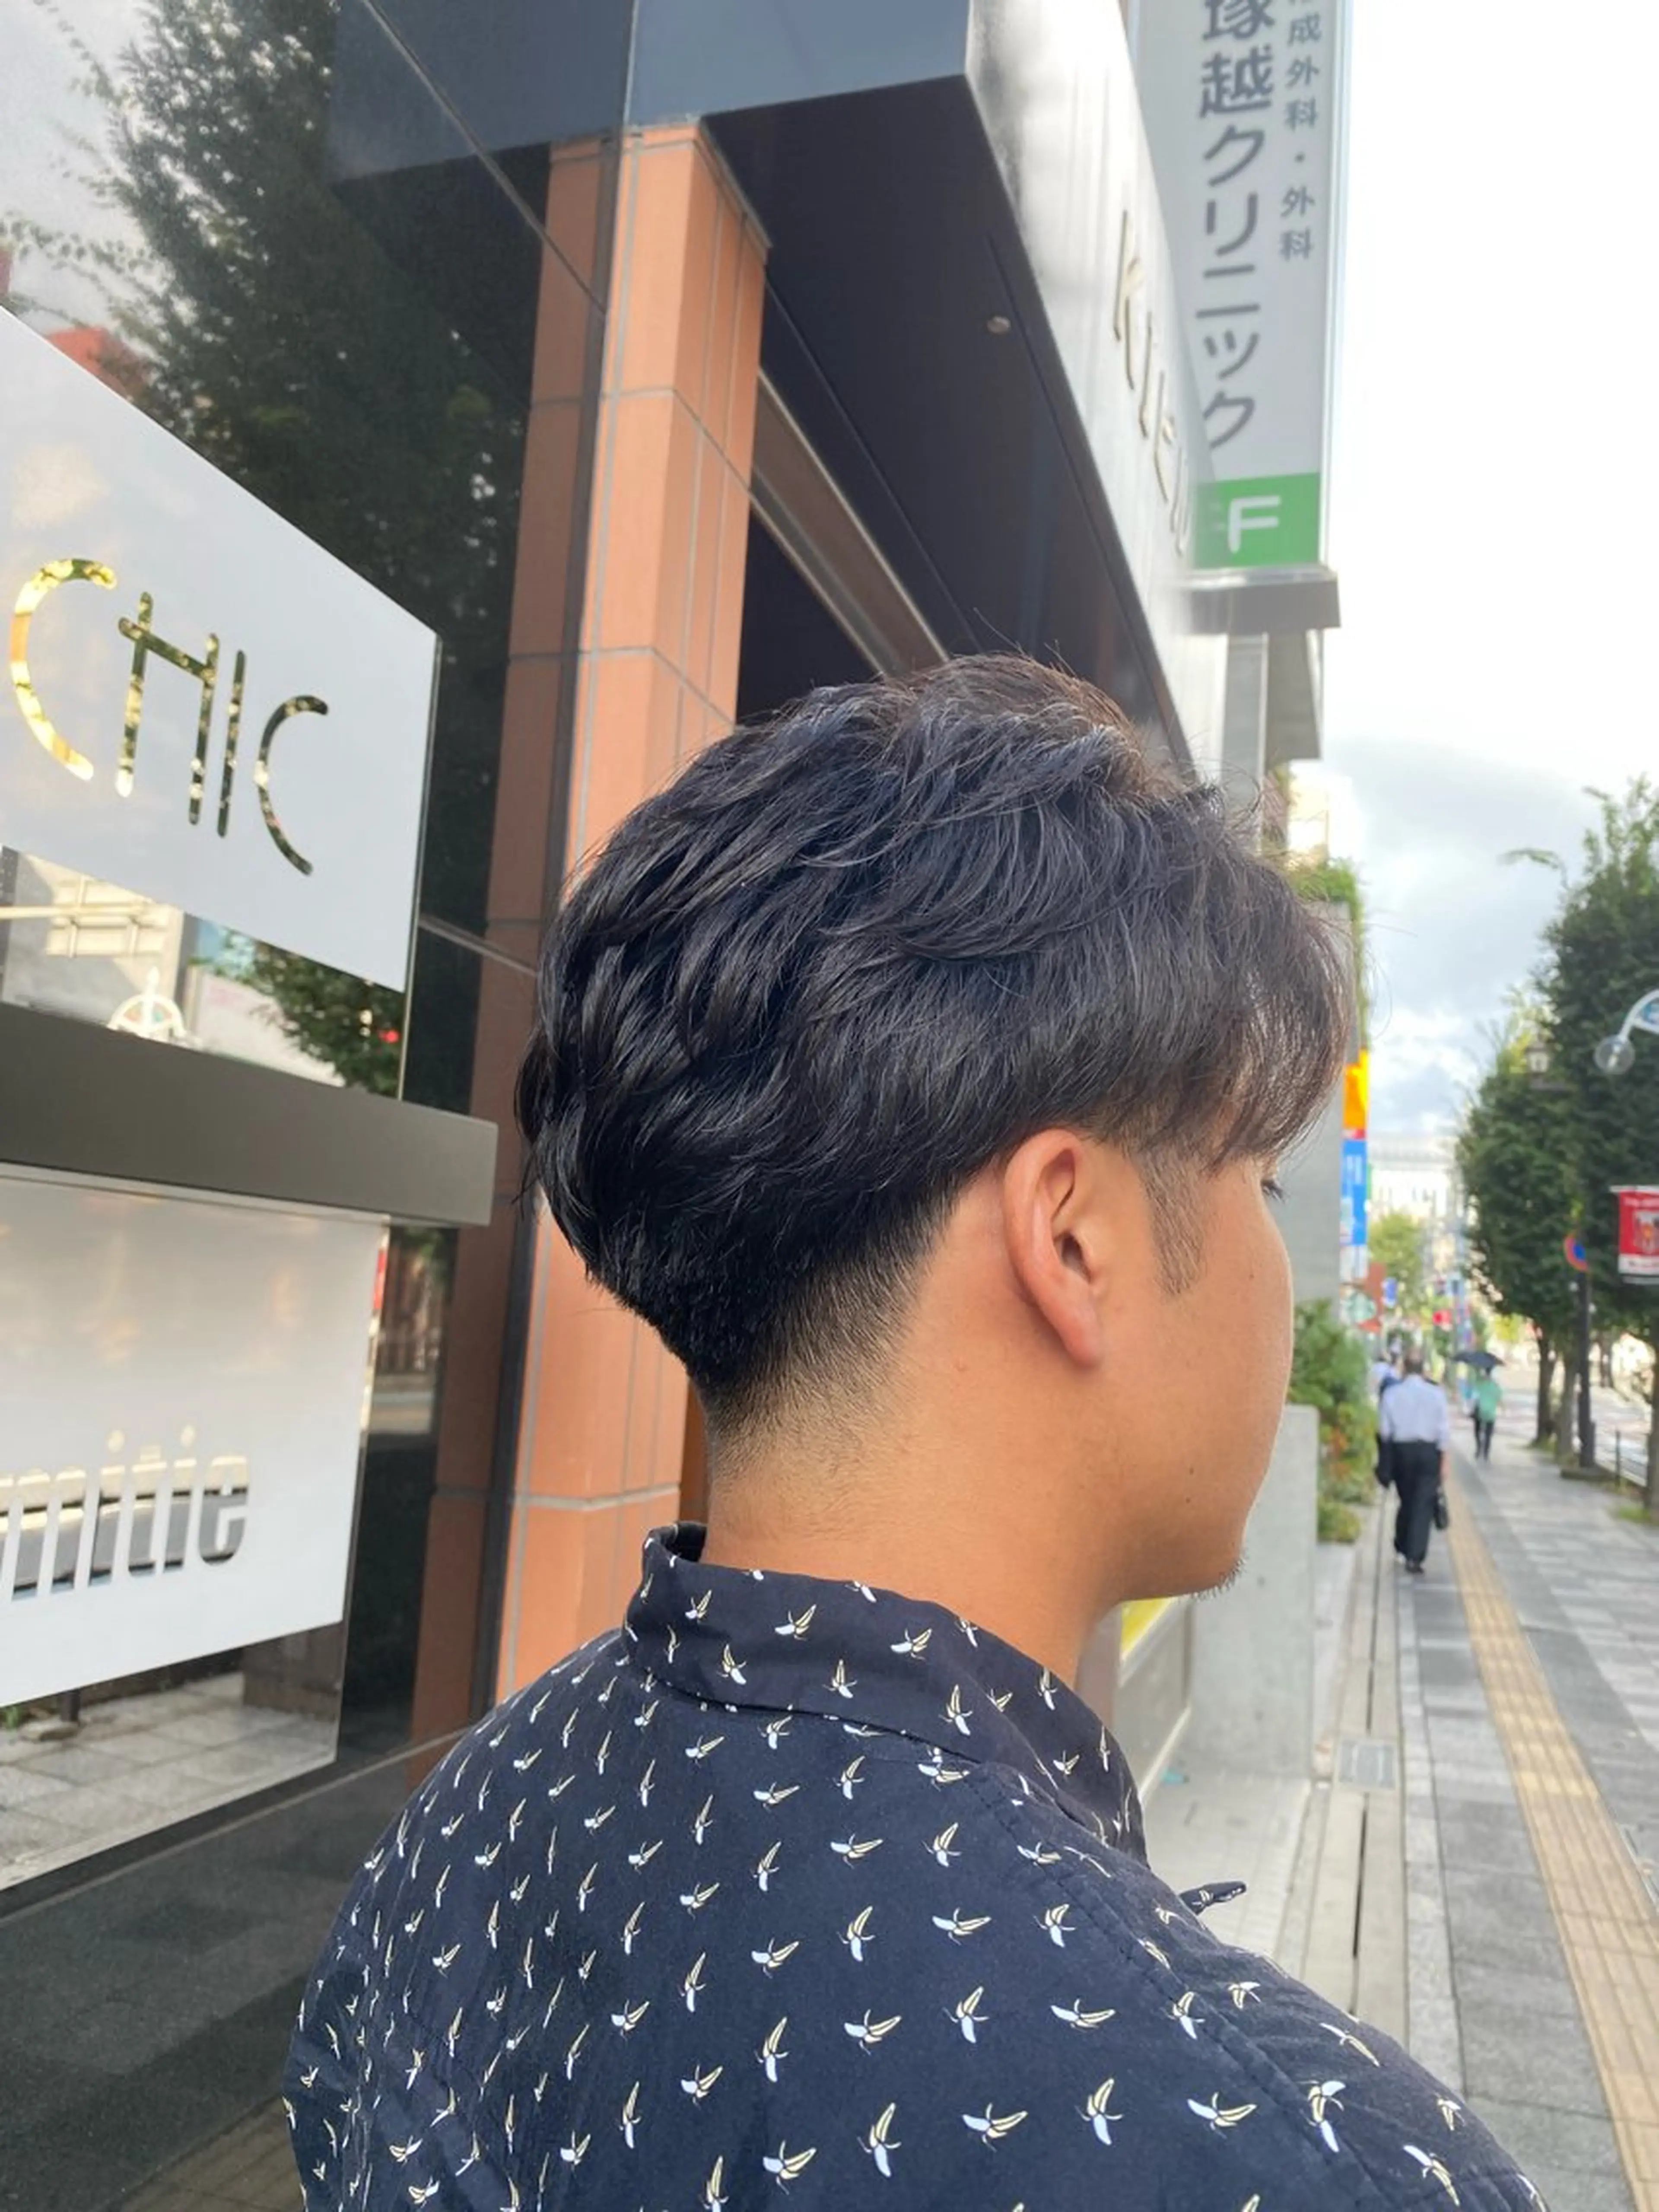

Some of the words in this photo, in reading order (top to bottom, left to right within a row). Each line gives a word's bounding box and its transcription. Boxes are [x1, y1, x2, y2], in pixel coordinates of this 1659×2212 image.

[1279, 0, 1322, 261] 成外科・外科
[1227, 495, 1281, 554] F
[10, 558, 329, 876] CHIC
